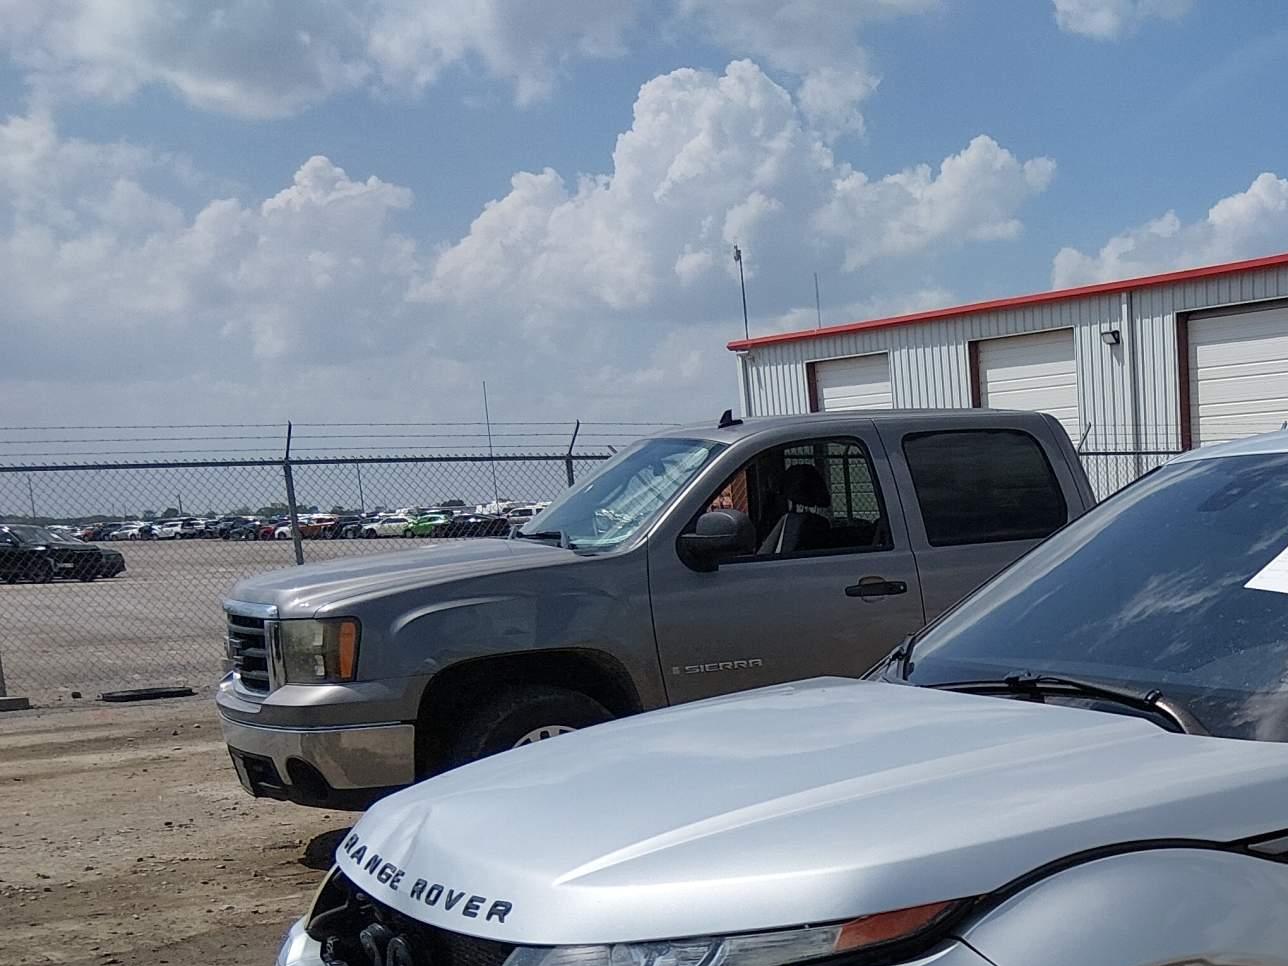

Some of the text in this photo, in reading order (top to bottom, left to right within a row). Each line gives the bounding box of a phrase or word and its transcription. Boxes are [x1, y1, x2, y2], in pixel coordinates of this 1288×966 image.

[684, 658, 763, 674] SIERRA
[344, 833, 513, 924] RANGE ROVER
